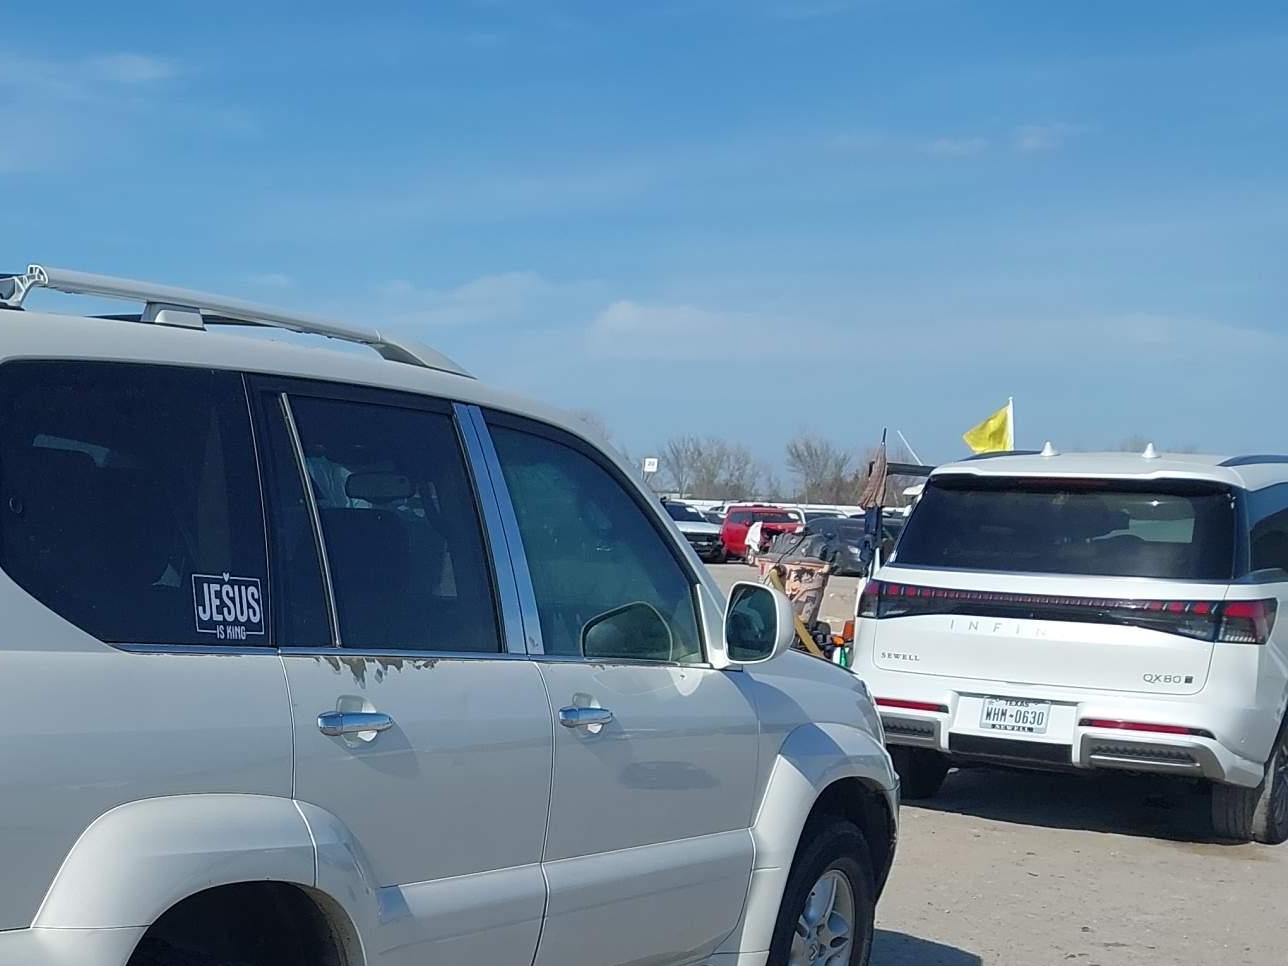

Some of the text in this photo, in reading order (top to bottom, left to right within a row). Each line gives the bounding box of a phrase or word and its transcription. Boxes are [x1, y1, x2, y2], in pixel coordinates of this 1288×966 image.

[198, 583, 261, 623] JESUS
[216, 625, 247, 640] IS KING
[950, 619, 1047, 636] INFIN
[881, 652, 921, 662] SEWELL
[1143, 673, 1182, 684] QX80
